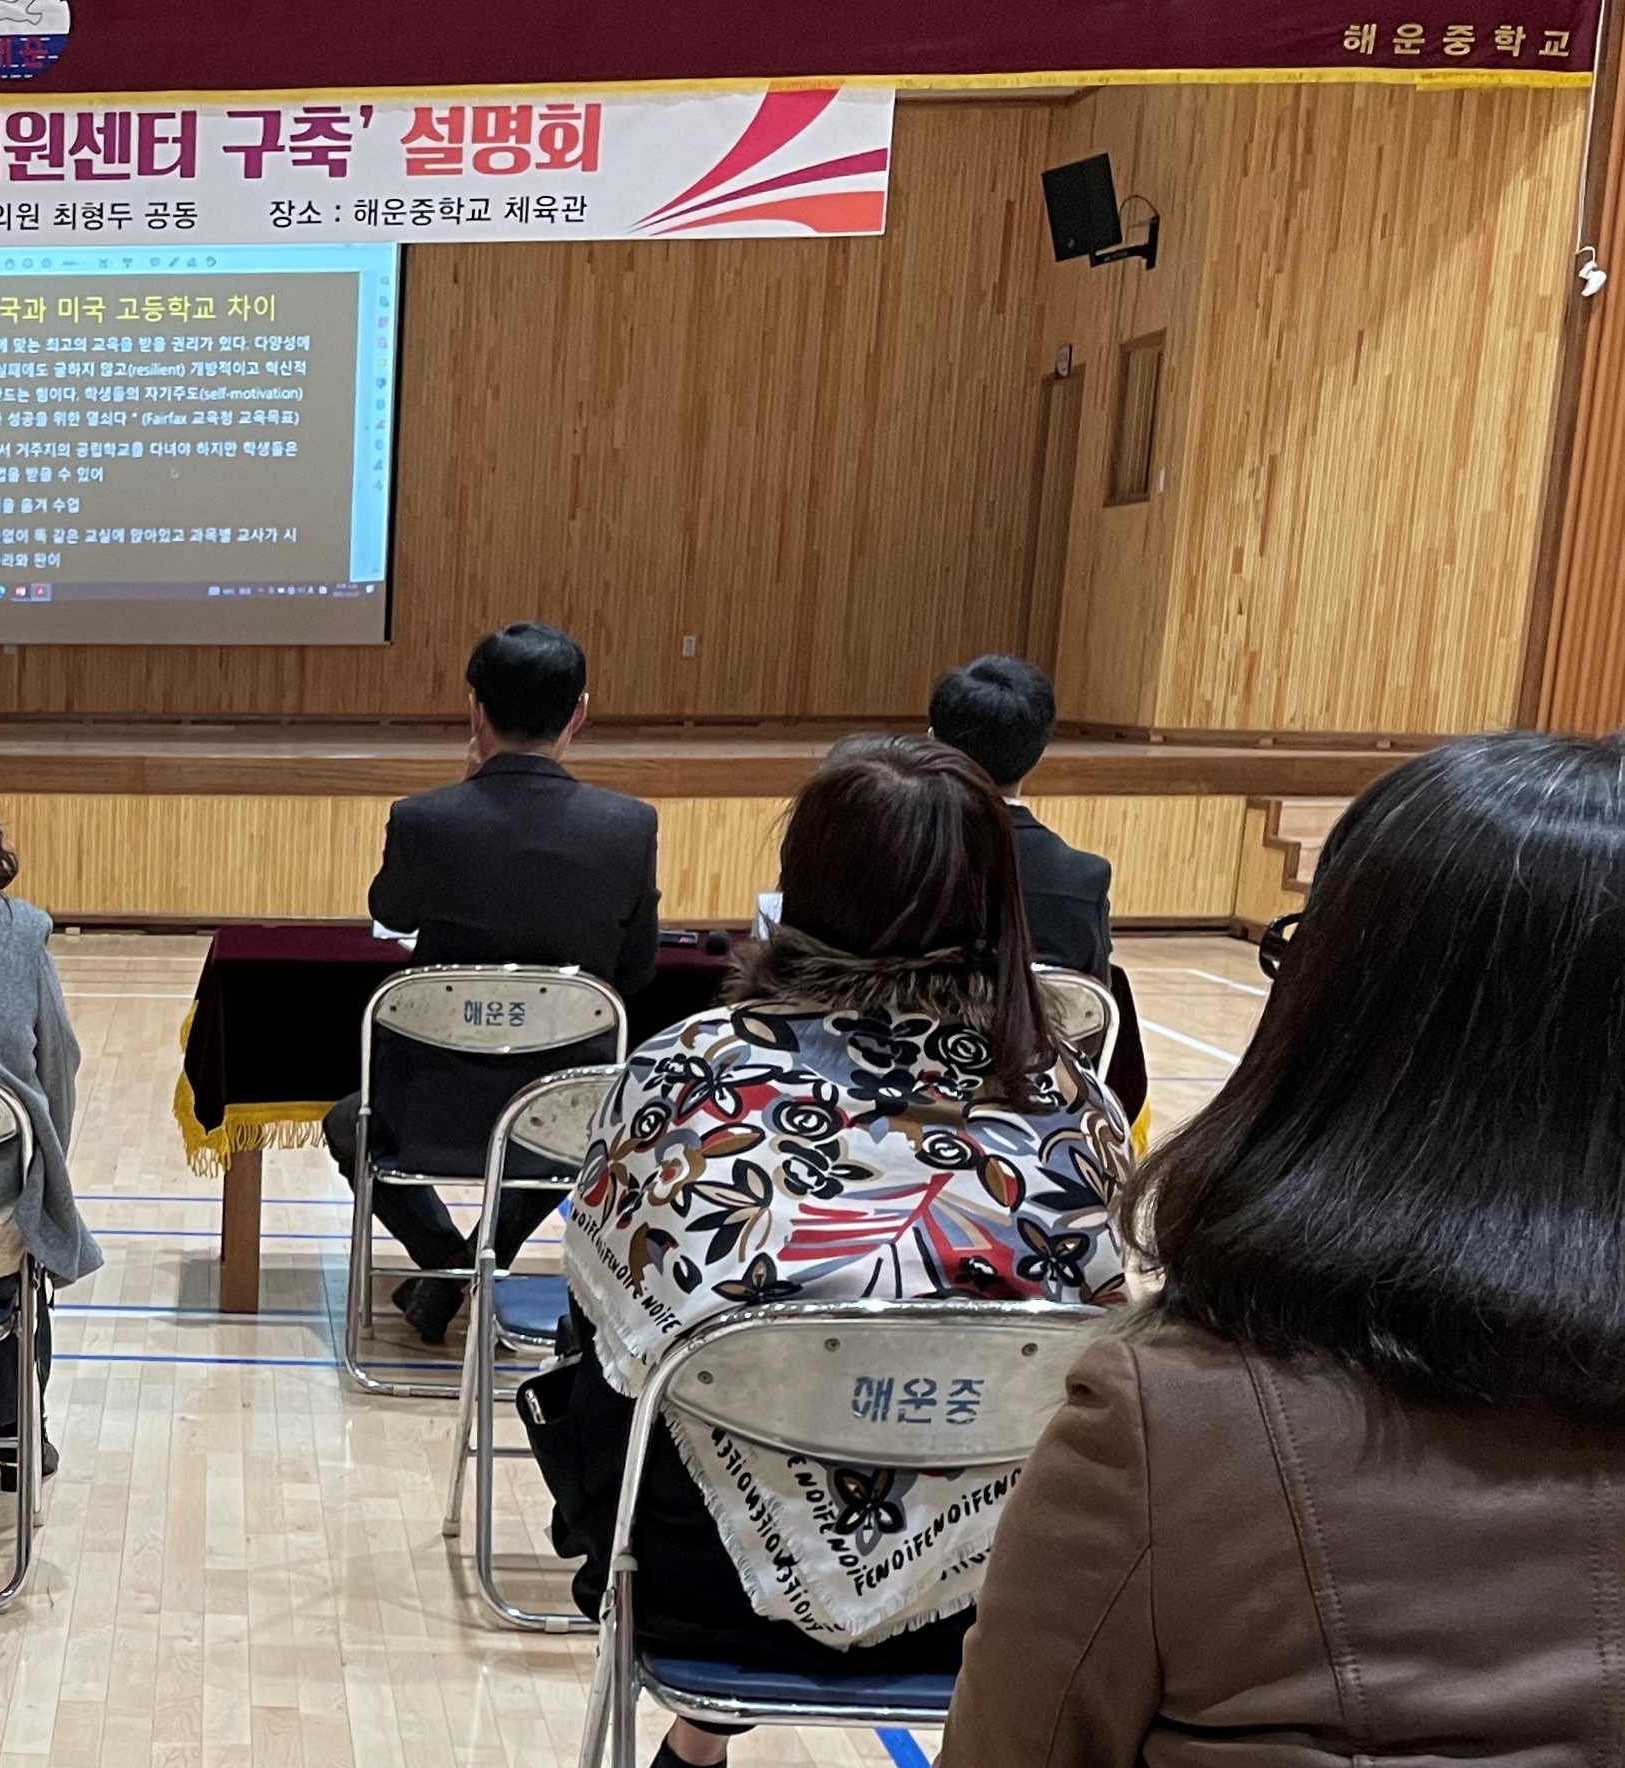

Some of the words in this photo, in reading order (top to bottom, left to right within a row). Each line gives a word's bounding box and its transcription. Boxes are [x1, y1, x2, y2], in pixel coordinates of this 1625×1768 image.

[1343, 23, 1570, 57] 해운중학교
[400, 103, 601, 177] 설명회
[54, 203, 132, 230] 최형두
[145, 202, 197, 229] 공동
[270, 200, 321, 227] 장소
[354, 197, 491, 226] 해운중학교
[504, 196, 587, 223] 체육관
[58, 296, 106, 323] 미국
[115, 295, 216, 322] 고등학교
[228, 295, 275, 322] 차이
[46, 336, 87, 352] 최고의
[91, 336, 133, 352] 교육을
[139, 336, 166, 352] 받을
[171, 336, 213, 352] 권리가
[255, 335, 310, 351] 다양성에
[190, 360, 260, 376] 개방적이고
[16, 442, 70, 458] 거주지의
[58, 467, 71, 481] 수
[284, 528, 296, 542] 시
[464, 1000, 526, 1027] 해운중
[851, 1376, 985, 1425] 해운중
